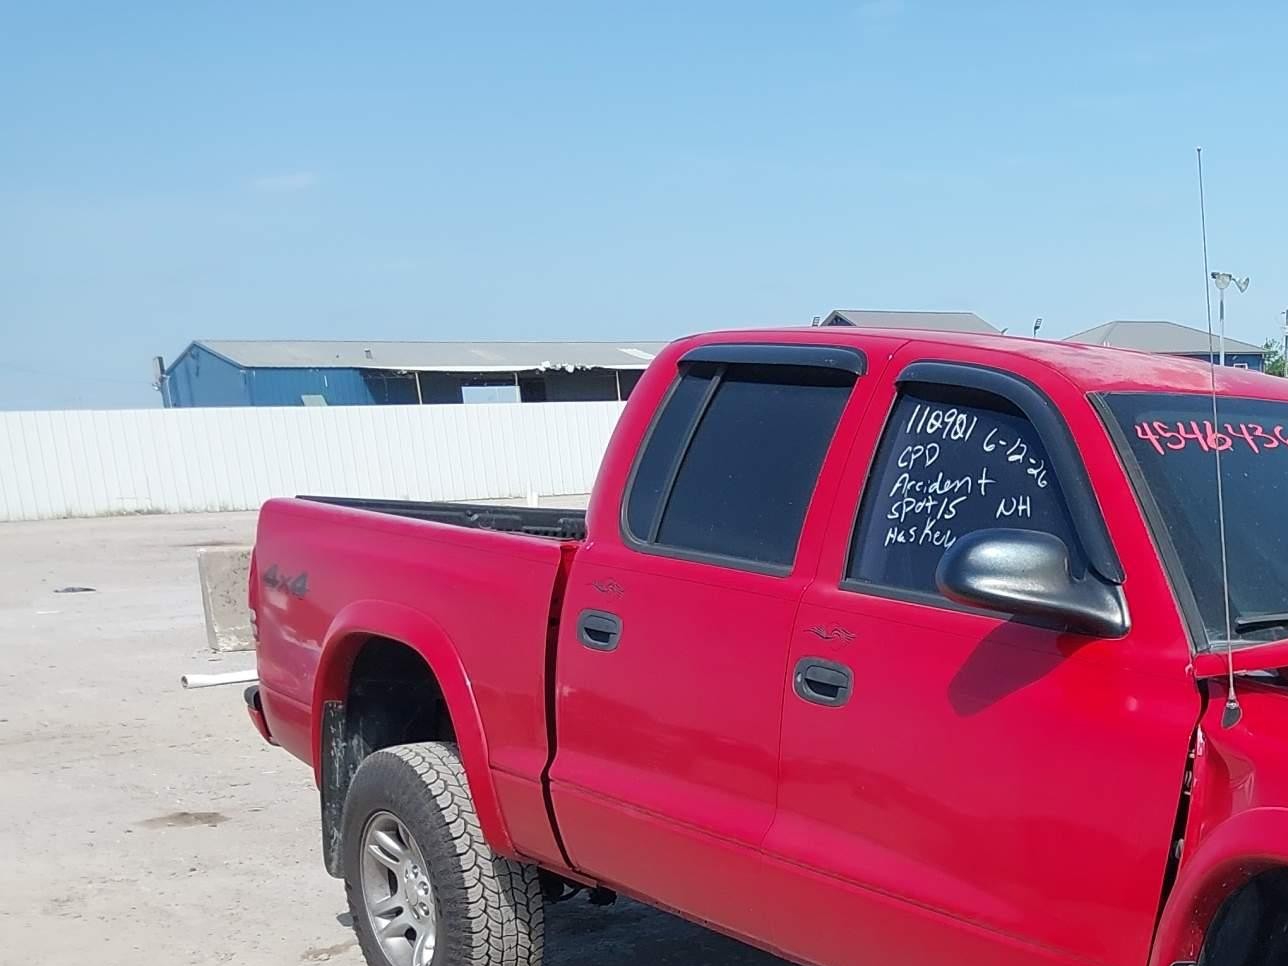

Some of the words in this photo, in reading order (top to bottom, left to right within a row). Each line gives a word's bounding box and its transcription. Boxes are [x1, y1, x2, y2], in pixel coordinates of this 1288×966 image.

[898, 443, 941, 469] CPD
[983, 427, 1048, 489] 6-12-26
[889, 467, 998, 498] Accident
[996, 496, 1031, 519] NH
